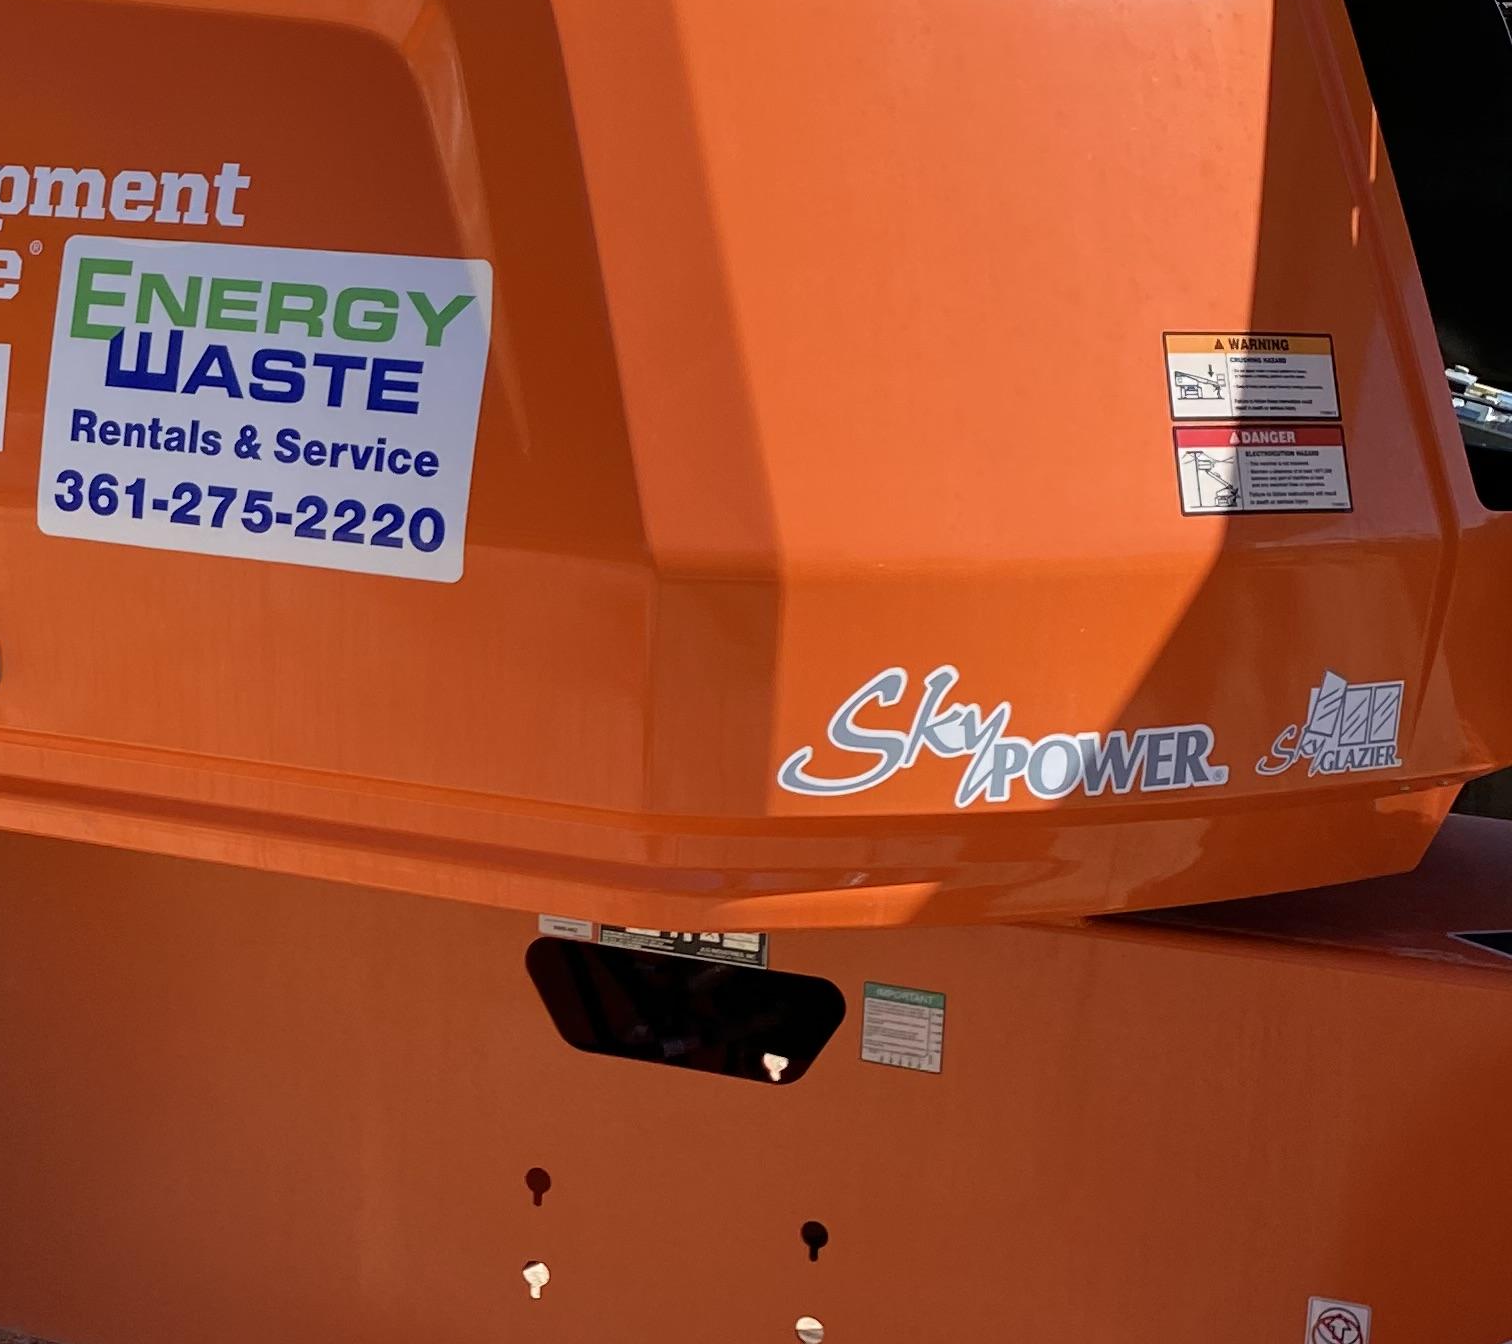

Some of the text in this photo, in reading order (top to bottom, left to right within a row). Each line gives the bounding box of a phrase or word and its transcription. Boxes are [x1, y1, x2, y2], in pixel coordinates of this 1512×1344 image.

[70, 258, 477, 348] ENERGY
[105, 328, 425, 416] WASTE
[1229, 338, 1289, 351] WARNING
[70, 409, 441, 479] Rentals & Service
[1241, 431, 1296, 444] DANGER
[53, 468, 447, 554] 361-275-2220
